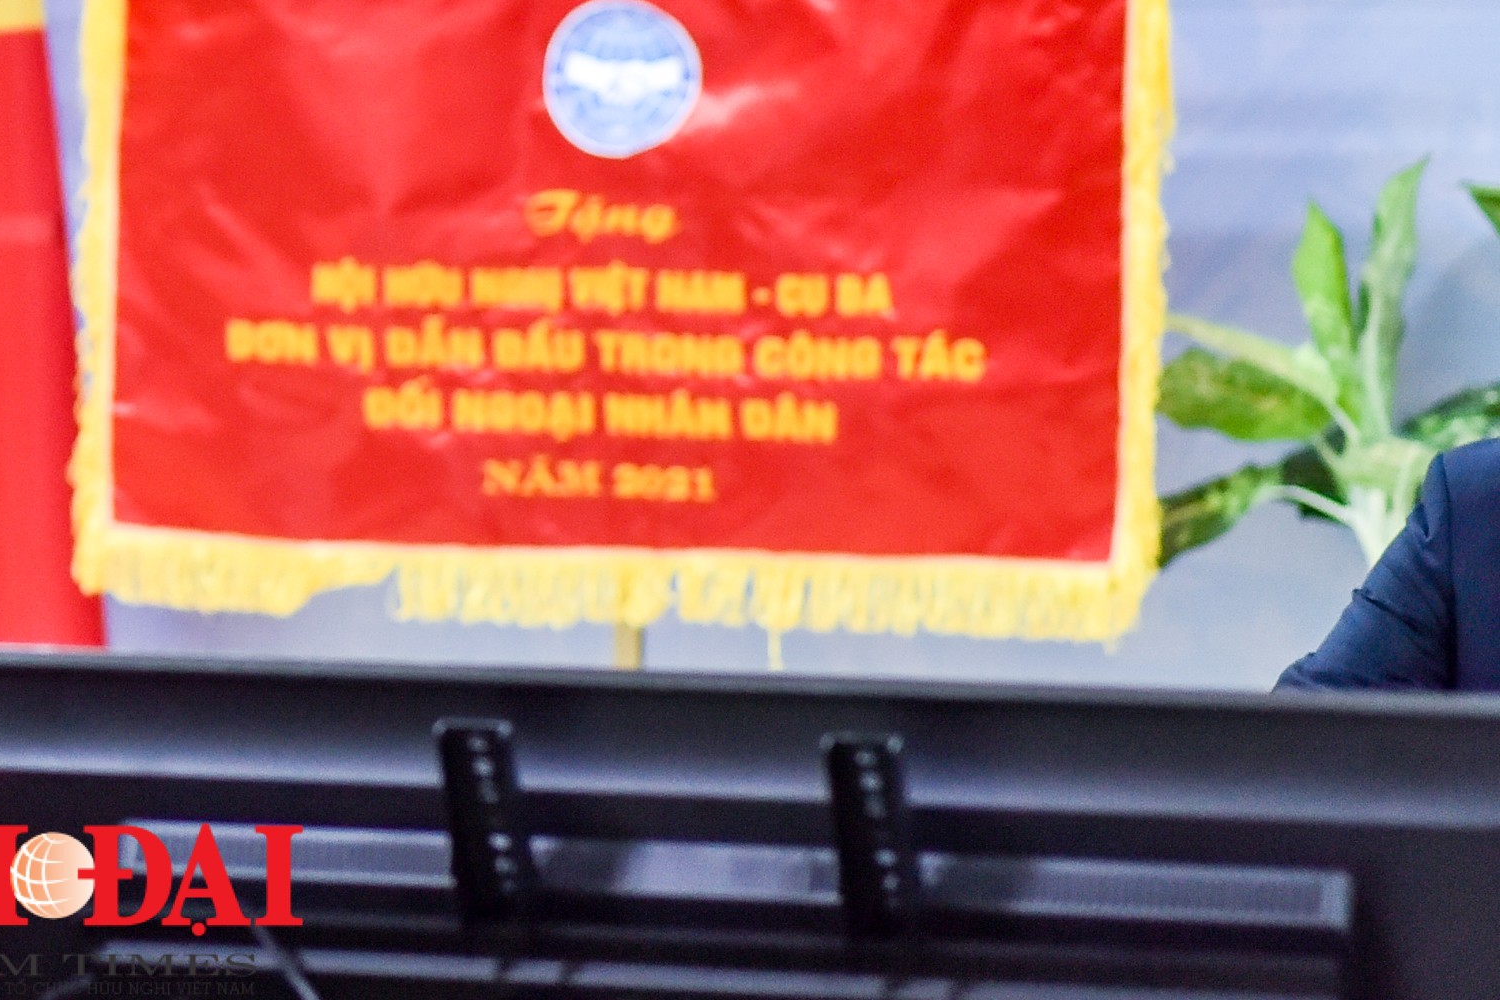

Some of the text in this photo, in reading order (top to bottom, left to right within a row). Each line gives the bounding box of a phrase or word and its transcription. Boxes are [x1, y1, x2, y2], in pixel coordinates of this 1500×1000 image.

[569, 260, 649, 317] VIỆT
[656, 269, 746, 315] NAM
[326, 325, 374, 376] VỊ
[592, 329, 744, 377] TRONG
[753, 330, 882, 381] CÔNG
[891, 329, 985, 384] TÁC
